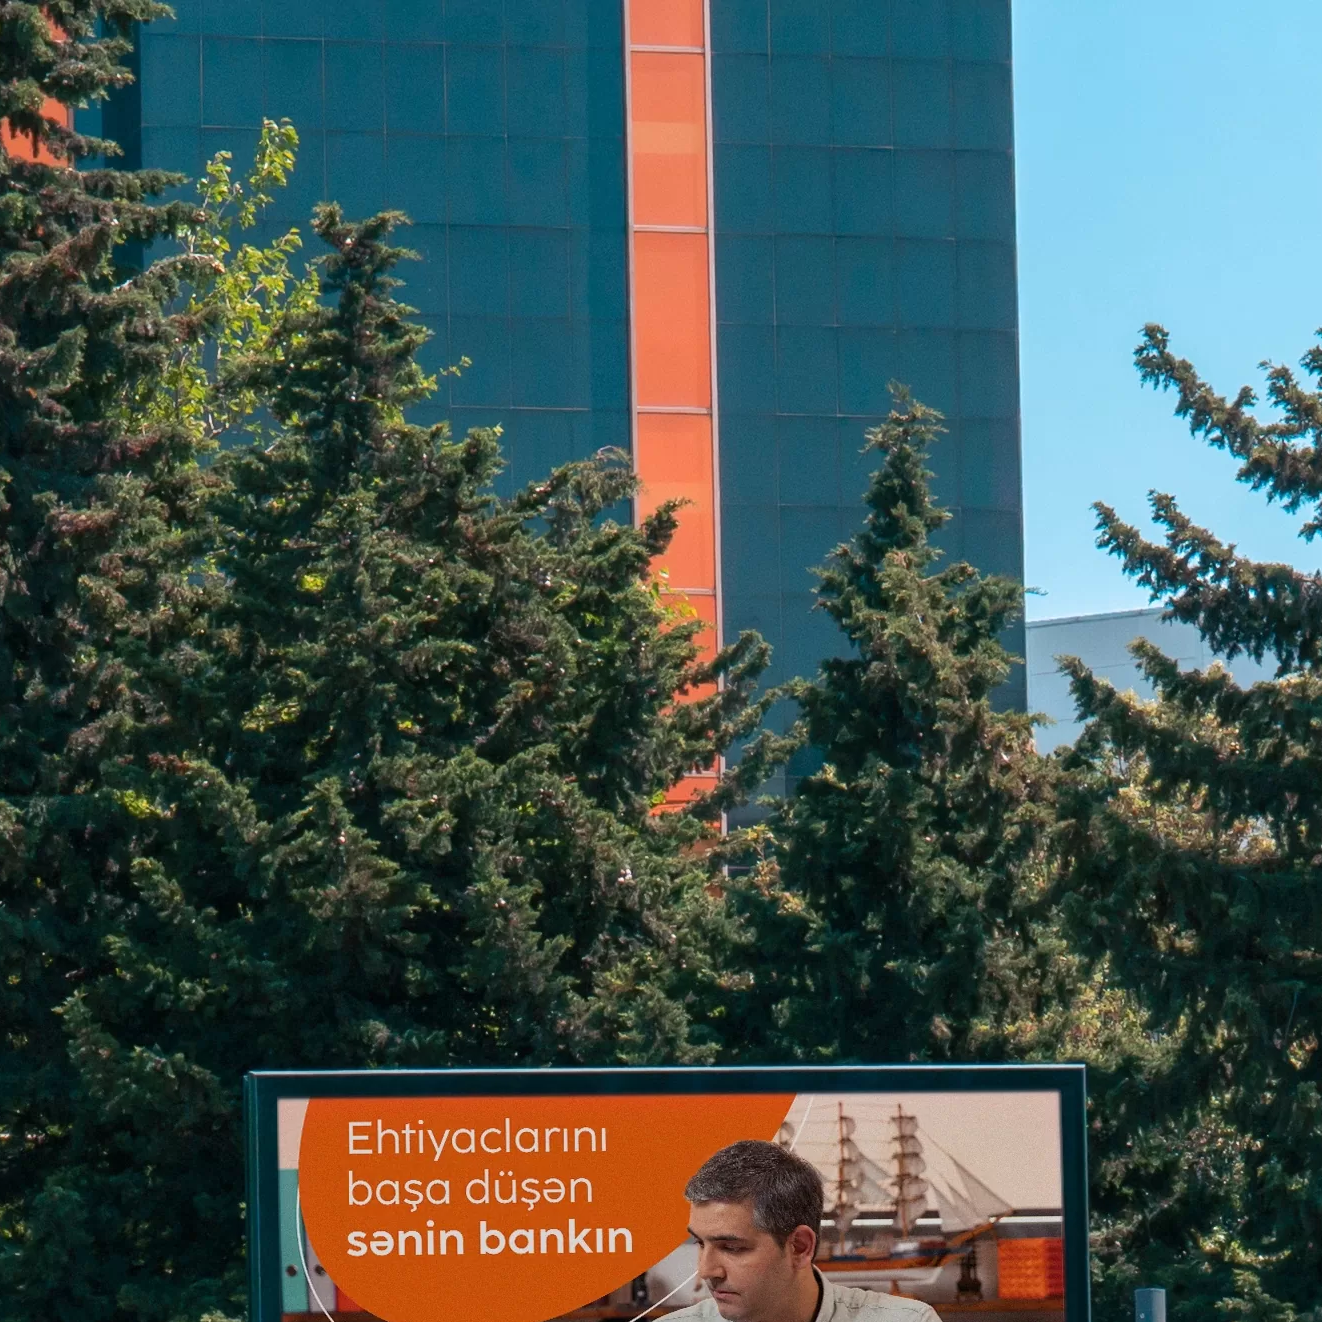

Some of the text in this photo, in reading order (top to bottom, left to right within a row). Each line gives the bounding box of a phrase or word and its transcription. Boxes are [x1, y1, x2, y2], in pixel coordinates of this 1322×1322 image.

[348, 1117, 607, 1161] Ehtiyaclarını
[348, 1168, 593, 1212] başa düşən
[346, 1218, 633, 1257] sənin bankın
